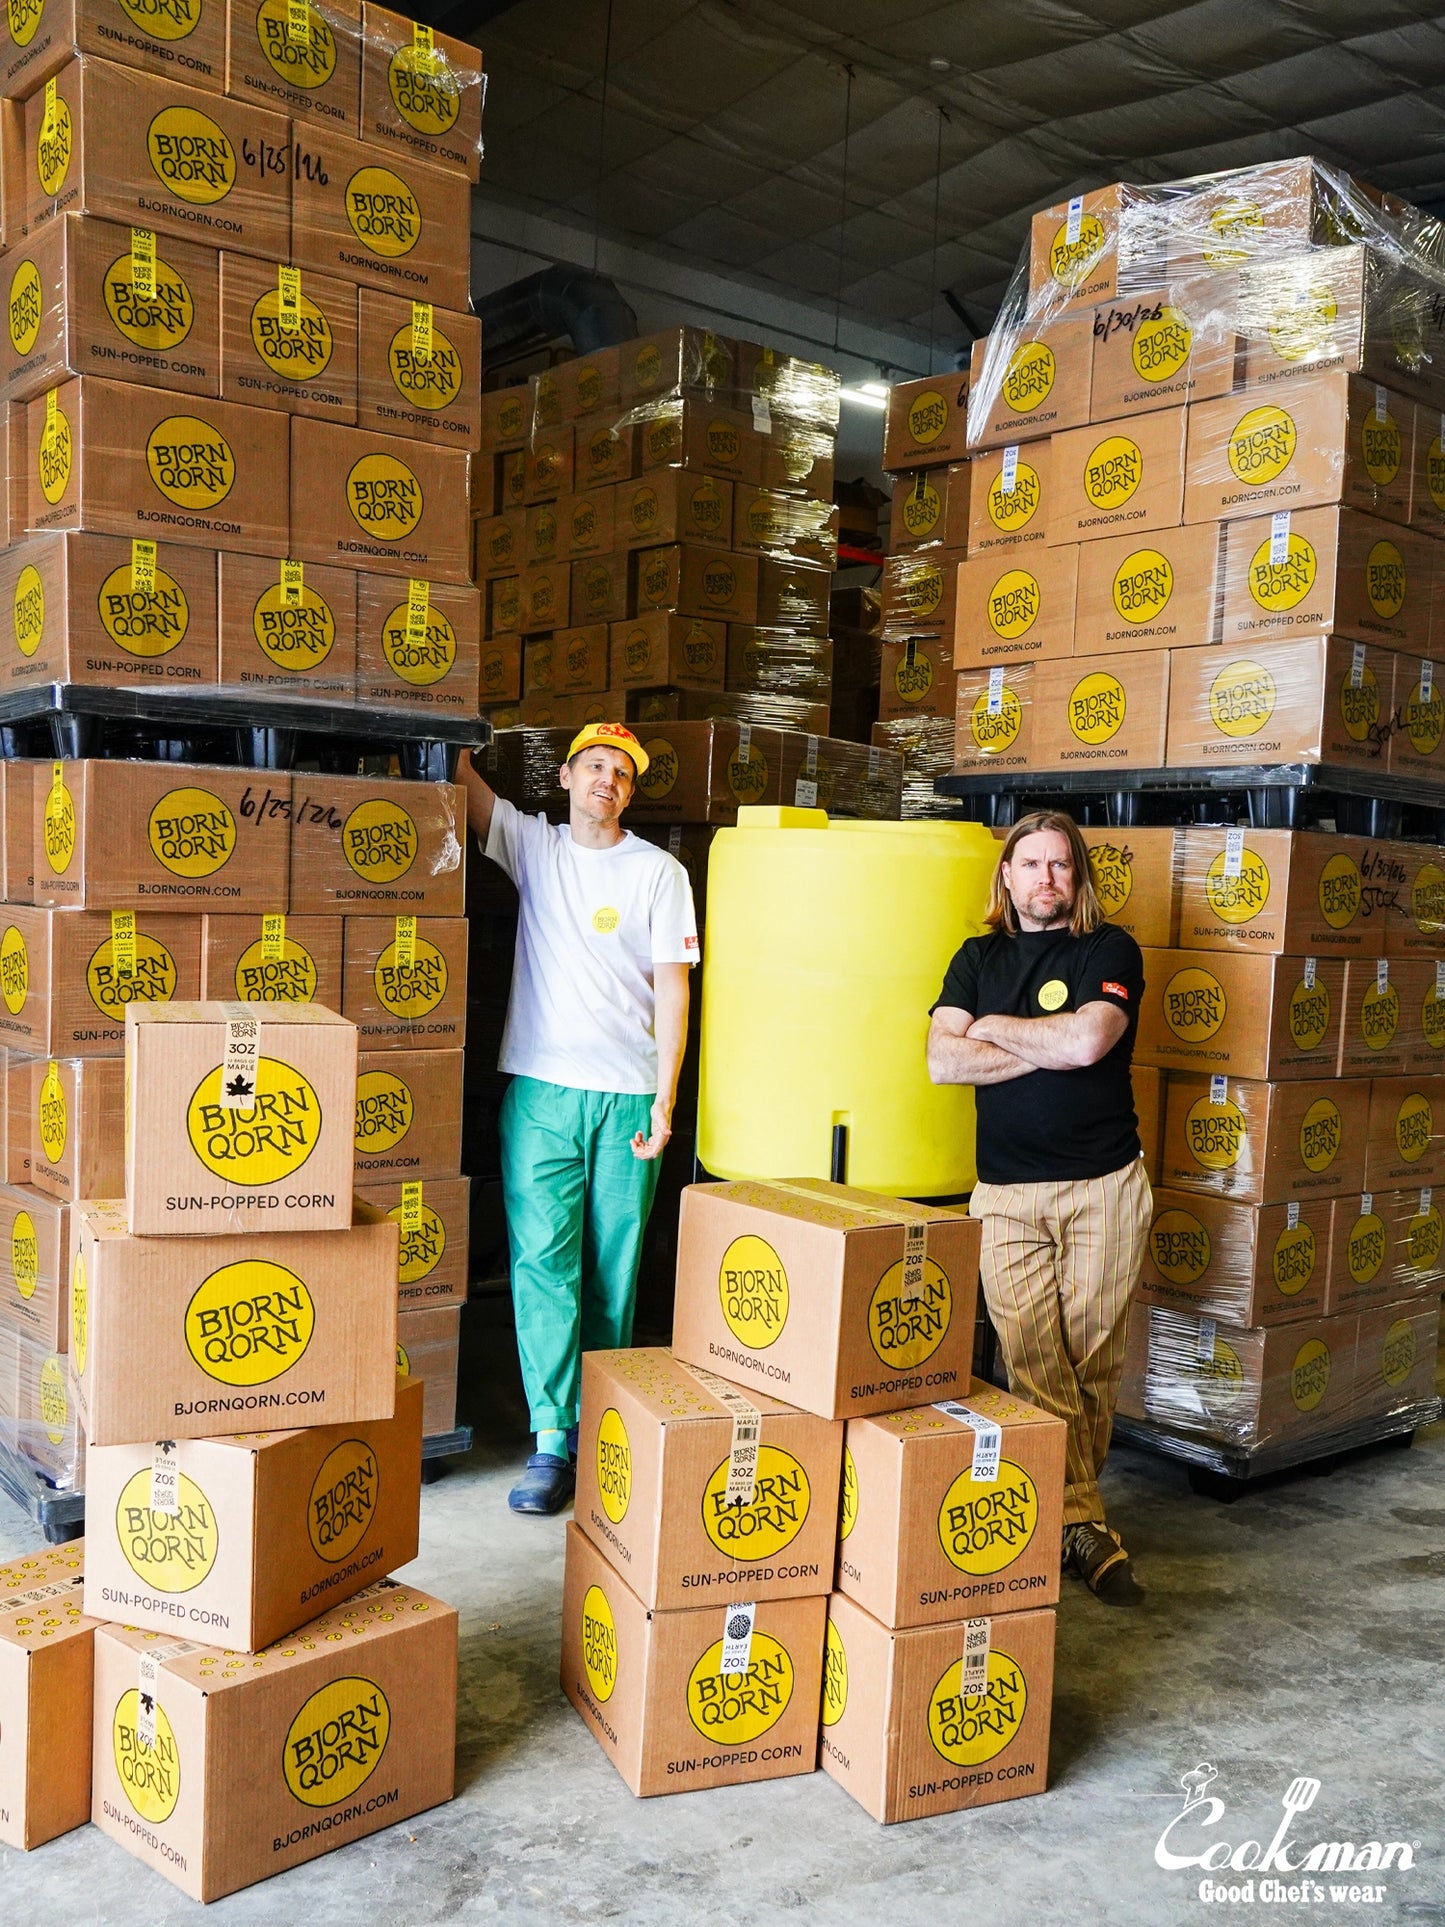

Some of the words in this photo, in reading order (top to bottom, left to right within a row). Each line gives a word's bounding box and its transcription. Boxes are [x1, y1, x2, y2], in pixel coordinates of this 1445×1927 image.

[154, 134, 229, 163] BJORN
[161, 158, 228, 188] QORN
[352, 193, 414, 219] BJORN
[357, 214, 414, 243] QORN
[133, 281, 152, 292] 3OZ
[117, 306, 185, 333] QORN
[413, 325, 429, 335] 3OZ
[263, 340, 324, 364] QORN
[1140, 339, 1186, 370] QORN
[400, 370, 454, 394] QORN
[1008, 353, 1051, 388] BJORN
[1009, 371, 1050, 401] QORN
[1234, 420, 1291, 457] BJORN
[153, 443, 228, 471] BJORN
[1088, 449, 1138, 484] BJORN
[1238, 441, 1289, 472] QORN
[160, 467, 226, 492] QORN
[353, 479, 417, 504] BJORN
[1092, 469, 1136, 498] QORN
[358, 501, 416, 524] QORN
[995, 493, 1034, 521] QORN
[137, 510, 241, 534] BJORNQORN.COM
[1118, 563, 1167, 595] BJORN
[1258, 569, 1309, 599] QORN
[106, 588, 181, 620] BJORN
[992, 583, 1035, 613] BJORN
[1120, 583, 1166, 611] QORN
[113, 613, 181, 638] QORN
[260, 607, 328, 634] BJORN
[995, 602, 1034, 627] QORN
[1237, 616, 1294, 631] SUN-POPPED
[1297, 613, 1323, 624] CORN
[266, 629, 327, 653] QORN
[86, 659, 164, 676] SUN-POPPED
[167, 665, 201, 678] CORN
[393, 645, 449, 668] QORN
[1073, 687, 1121, 717] BJORN
[978, 718, 1016, 741] QORN
[1075, 707, 1119, 732] QORN
[1060, 749, 1128, 760] BJORNQORN.COM
[155, 810, 229, 843] BJORN
[349, 819, 412, 849] BJORN
[161, 833, 228, 859] QORN
[354, 842, 411, 867] QORN
[138, 883, 241, 897] BJORNQORN.COM
[336, 890, 425, 900] BJORNQORN.COM
[1322, 872, 1359, 899] BJORN
[1324, 891, 1357, 913] QORN
[263, 934, 280, 942] 3OZ
[397, 930, 412, 938] 3OZ
[241, 955, 310, 987] BJORN
[100, 977, 169, 1005] QORN
[385, 977, 441, 1003] QORN
[1168, 987, 1221, 1013] BJORN
[1171, 1006, 1219, 1028] QORN
[1293, 994, 1327, 1020] BJORN
[361, 1025, 425, 1035] SUN-POPPED
[427, 1024, 456, 1033] CORN
[229, 1043, 255, 1055] 3OZ
[208, 1120, 307, 1160] QORN
[1191, 1116, 1242, 1140] BJORN
[166, 1196, 279, 1211] SUN-POPPED
[284, 1194, 335, 1209] CORN
[1155, 1231, 1205, 1251] BJORN
[1277, 1236, 1313, 1267] BJORN
[1351, 1225, 1384, 1256] BJORN
[906, 1254, 923, 1266] 3OZ
[1157, 1252, 1204, 1271] QORN
[724, 1269, 783, 1301] BJORN
[196, 1286, 304, 1340] BJORN
[728, 1296, 781, 1329] QORN
[204, 1318, 302, 1363] QORN
[880, 1307, 943, 1350] QORN
[708, 1343, 791, 1384] BJORNQORN.COM
[850, 1377, 922, 1399] SUN-POPPED
[925, 1371, 957, 1387] CORN
[174, 1390, 325, 1416] BJORNQORN.COM
[600, 1440, 629, 1472] BJORN
[155, 1473, 176, 1485] 3OZ
[600, 1466, 627, 1505] QORN
[731, 1468, 754, 1477] 3OZ
[975, 1466, 995, 1477] 3OZ
[313, 1455, 374, 1525] BJORN
[318, 1487, 372, 1547] QORN
[717, 1500, 799, 1540] QORN
[947, 1481, 1030, 1533] BJORN
[952, 1511, 1028, 1555] QORN
[131, 1535, 208, 1570] QORN
[300, 1547, 384, 1605] BJORNQORN.COM
[681, 1568, 774, 1588] SUN-POPPED
[777, 1564, 819, 1579] CORN
[920, 1581, 1005, 1605] SUN-POPPED
[1008, 1575, 1047, 1591] CORN
[101, 1587, 187, 1619] SUN-POPPED
[189, 1607, 230, 1629] CORN
[584, 1615, 614, 1652] BJORN
[585, 1642, 612, 1686] QORN
[724, 1658, 746, 1668] 3OZ
[963, 1684, 984, 1694] 3OZ
[576, 1682, 618, 1746] BJORNQORN.COM
[702, 1683, 782, 1726] QORN
[291, 1693, 381, 1768] BJORN
[941, 1701, 1016, 1748] QORN
[299, 1726, 380, 1790] QORN
[666, 1751, 758, 1775] SUN-POPPED
[761, 1745, 803, 1760] CORN
[122, 1757, 173, 1804] QORN
[909, 1772, 994, 1798] SUN-POPPED
[997, 1763, 1035, 1780] CORN
[272, 1788, 399, 1852] BJORNQORN.COM
[102, 1800, 159, 1850] SUN-POPPED
[160, 1842, 188, 1872] CORN
